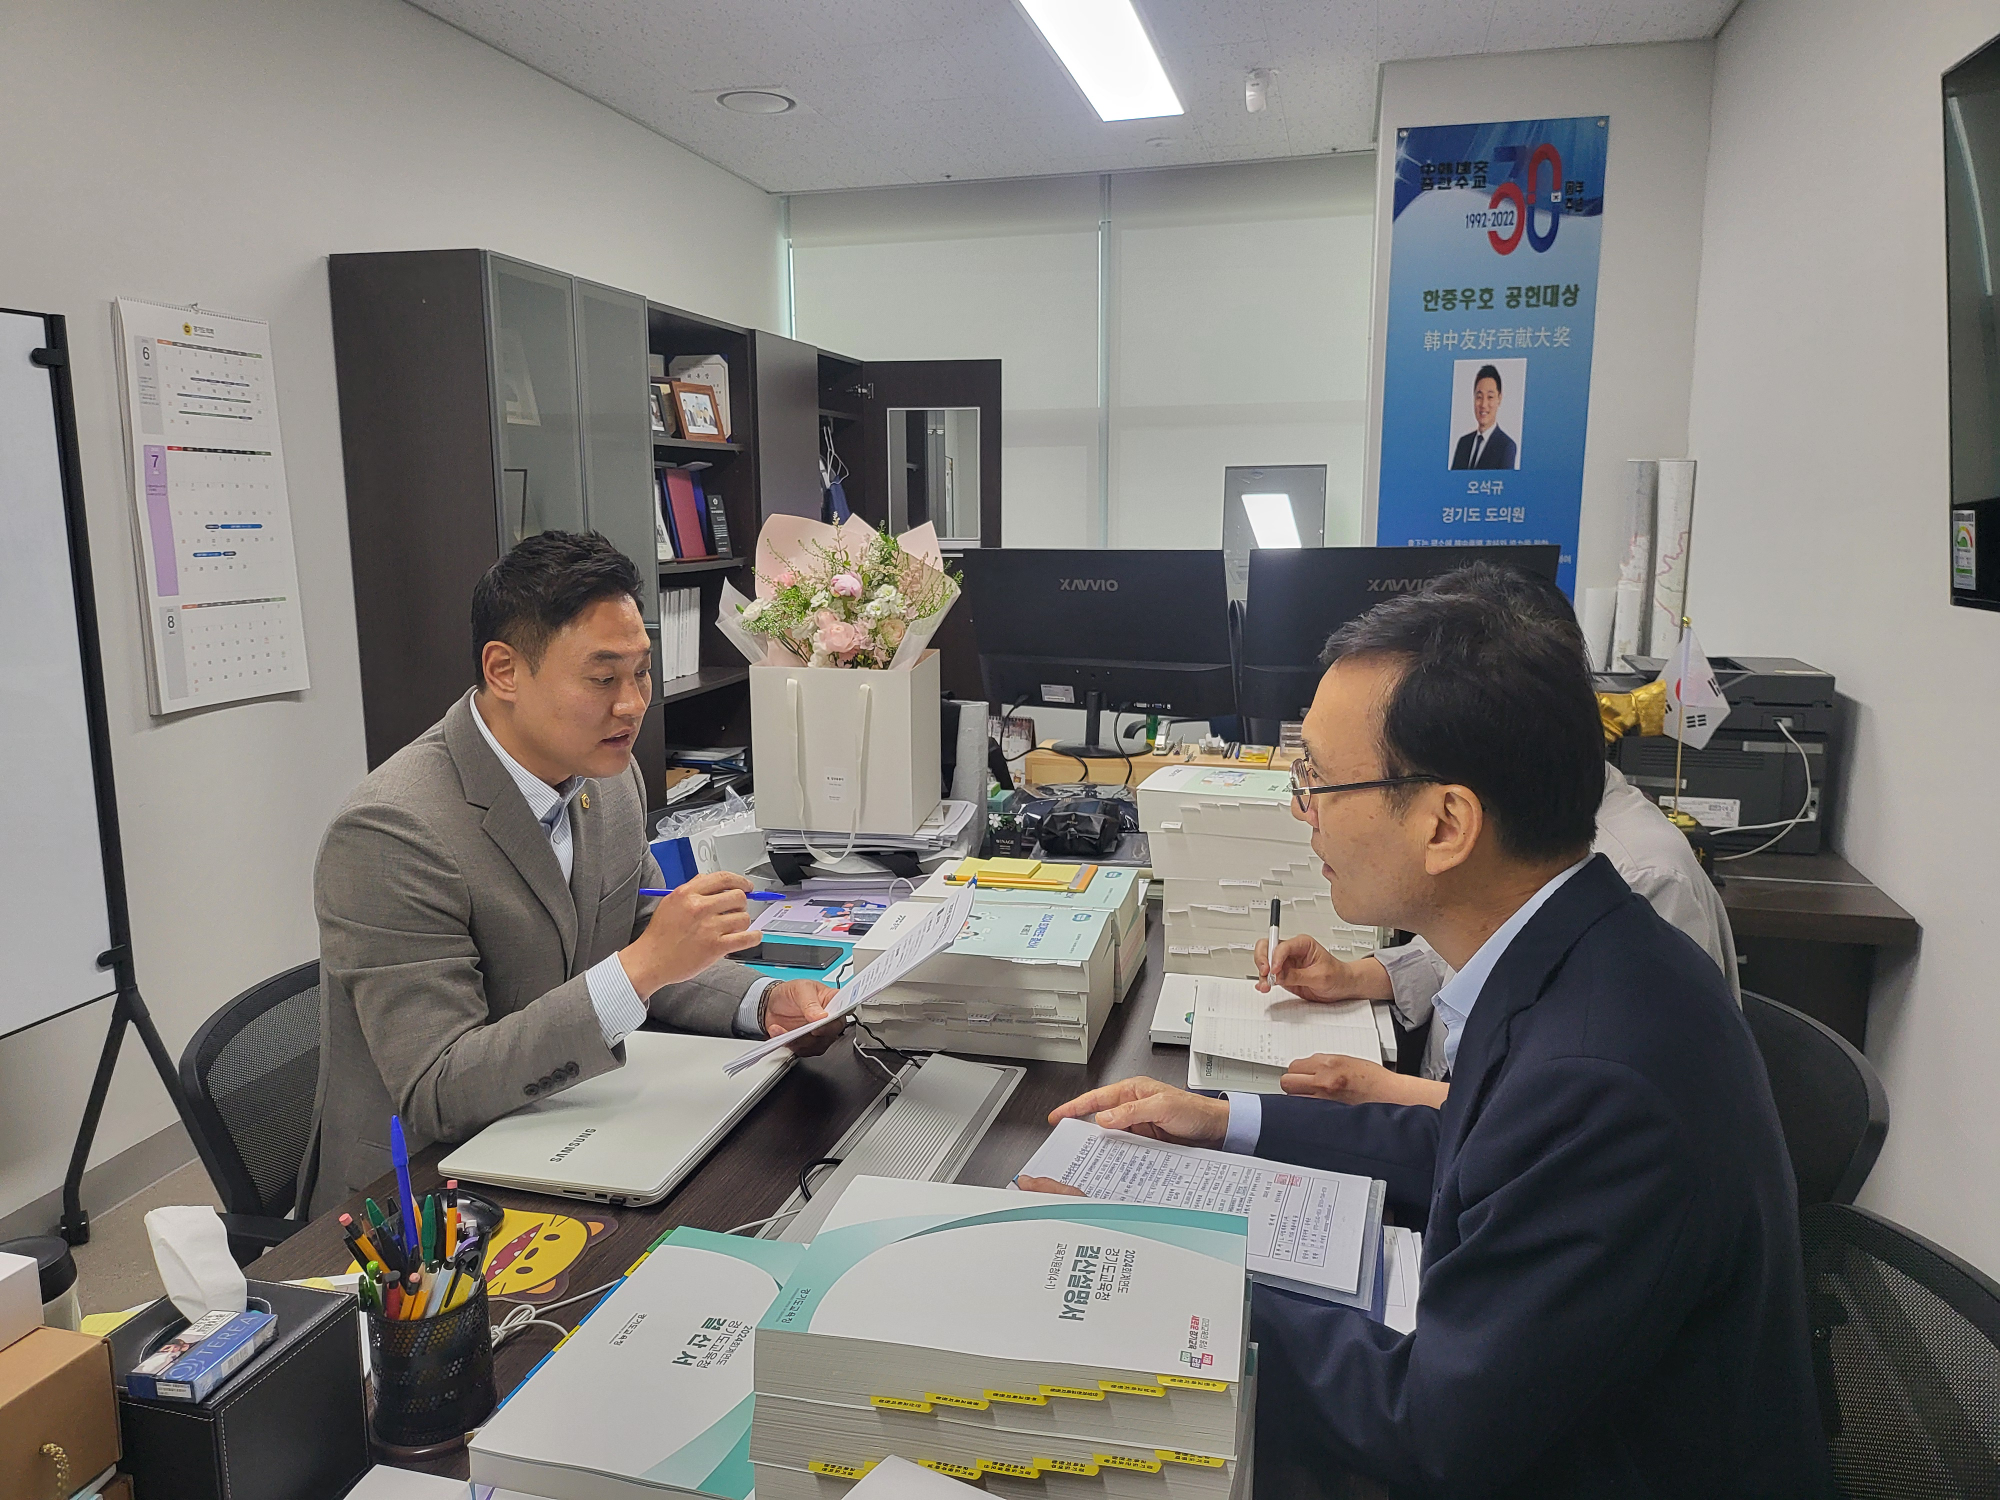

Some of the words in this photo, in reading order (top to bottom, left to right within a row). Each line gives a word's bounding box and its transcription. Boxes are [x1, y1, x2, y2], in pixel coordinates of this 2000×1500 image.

[1423, 287, 1495, 312] 한중우호
[1504, 284, 1580, 309] 공헌대상
[142, 347, 150, 360] 6
[1424, 327, 1571, 351] 韩中友好贡献大奖
[151, 454, 159, 468] 7
[1466, 480, 1504, 495] 오석규
[1442, 507, 1481, 523] 경기도
[1484, 506, 1525, 523] 도의원
[167, 615, 175, 628] 8
[549, 1128, 597, 1163] SAMSUNG
[1044, 1242, 1068, 1290] 교육지원청(4-1)
[1058, 1244, 1101, 1322] 결산설명서
[1095, 1247, 1121, 1301] 경기도교육청
[1117, 1249, 1136, 1294] 2024회계연도
[781, 1288, 812, 1325] 경기도교육청
[195, 1316, 259, 1355] TEREA
[613, 1313, 648, 1346] 경기도교육청
[671, 1315, 728, 1367] 결산서
[696, 1320, 743, 1369] 경기도교육청
[716, 1325, 753, 1366] 2024회계연도
